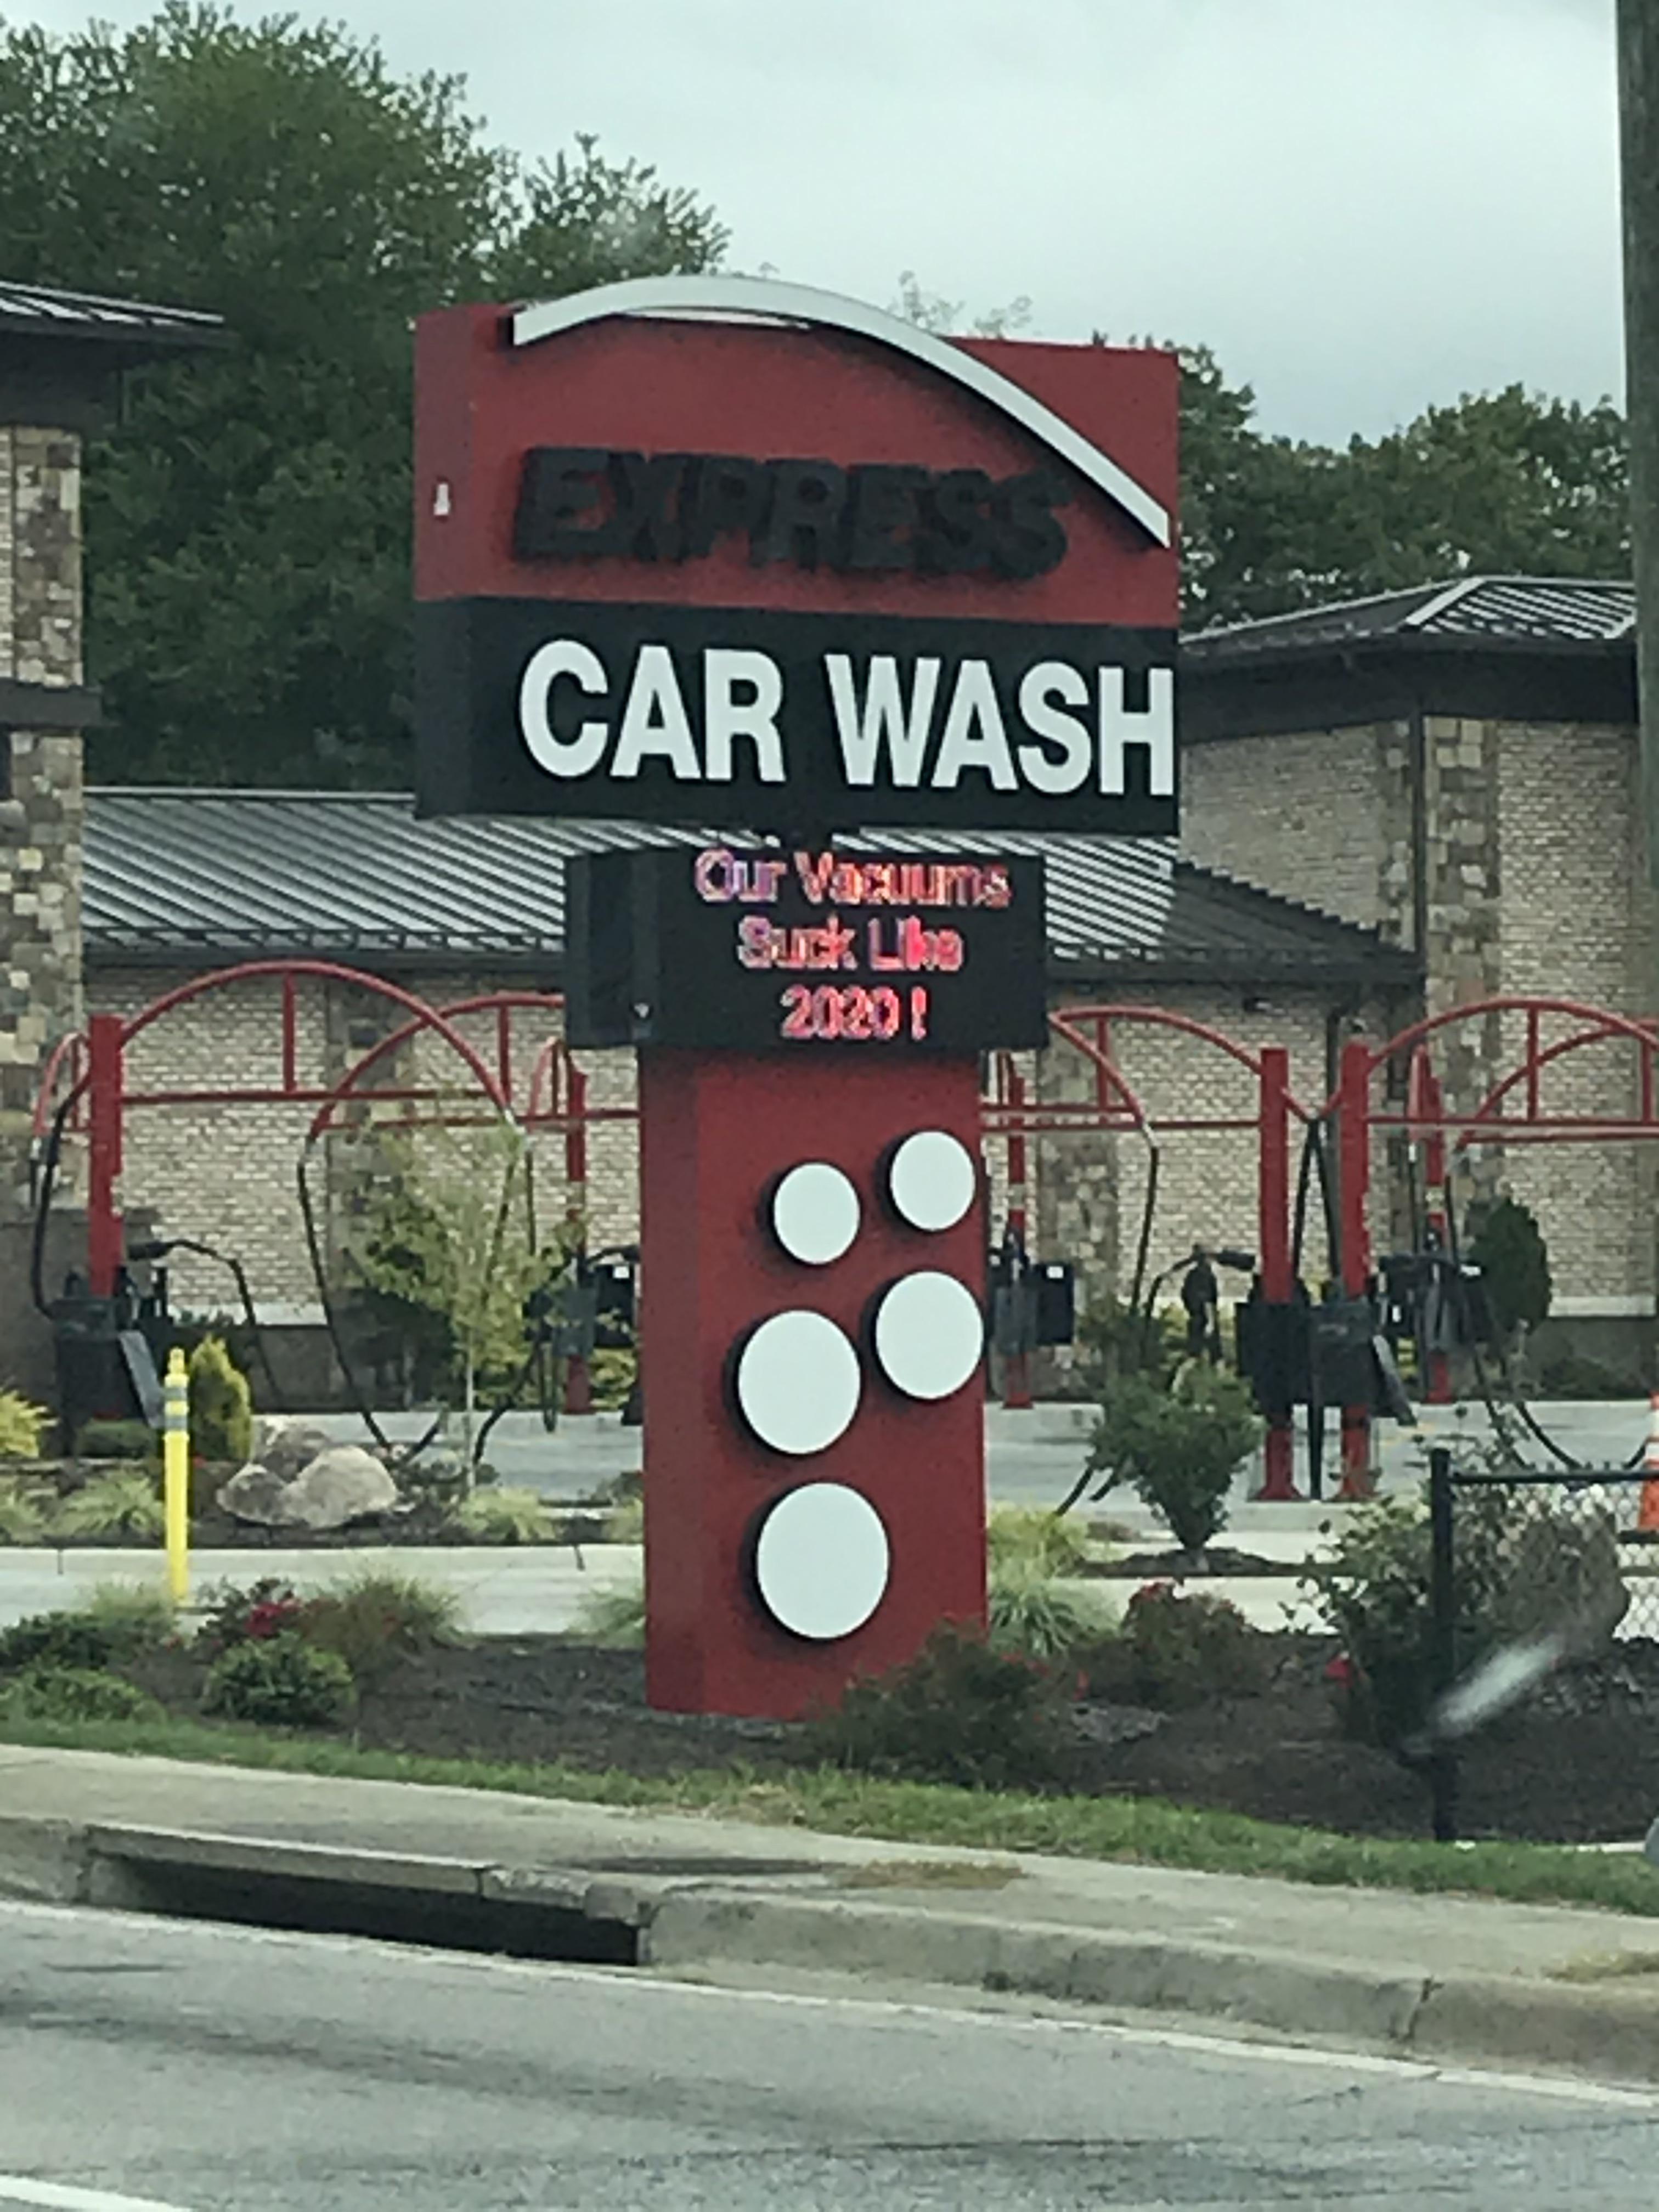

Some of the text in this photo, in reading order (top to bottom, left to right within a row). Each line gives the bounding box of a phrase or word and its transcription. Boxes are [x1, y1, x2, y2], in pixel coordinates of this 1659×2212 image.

[514, 445, 1071, 579] EXPRESS
[518, 639, 1174, 796] CAR WASH
[695, 848, 1011, 907] Our Vacuums
[737, 912, 963, 970] Suck Like
